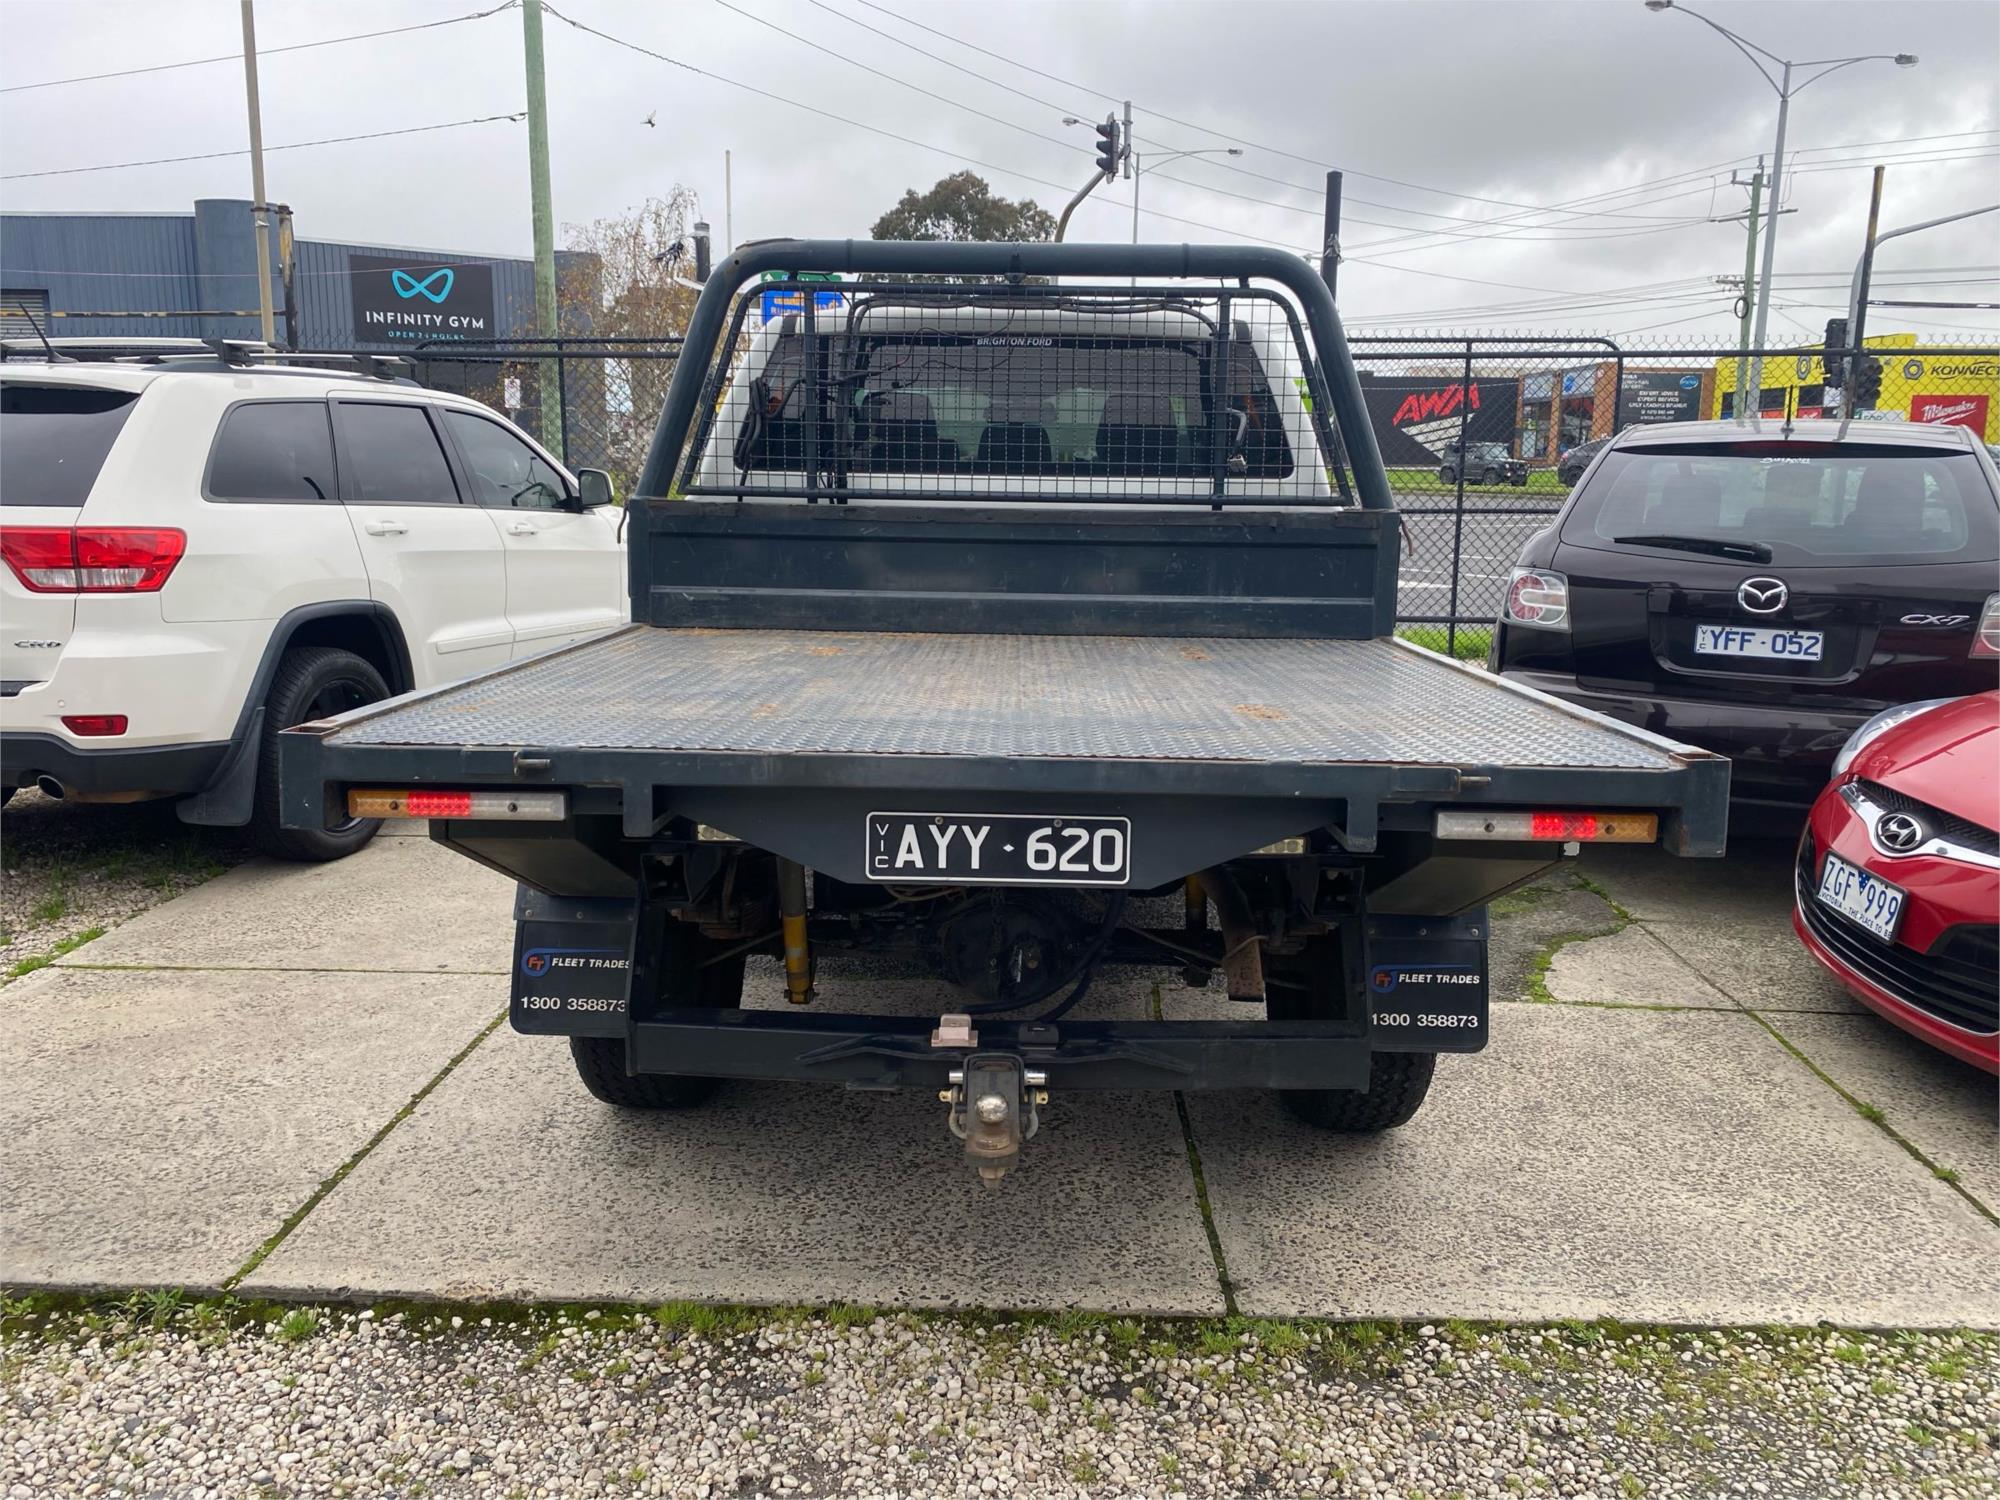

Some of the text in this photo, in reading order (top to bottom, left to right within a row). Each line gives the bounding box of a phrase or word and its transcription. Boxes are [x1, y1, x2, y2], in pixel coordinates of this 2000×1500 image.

[365, 311, 484, 329] INFINITY GYM
[388, 330, 415, 339] OPEN
[1026, 338, 1053, 346] FORD
[1900, 613, 1970, 626] CX-7
[14, 640, 62, 649] CRD
[1699, 629, 1708, 650] VIC
[1710, 629, 1820, 656] YFF 052
[874, 823, 889, 868] VIC
[894, 823, 1124, 873] AYY 620
[1823, 860, 1899, 926] ZGF 999
[1848, 906, 1859, 918] THE
[1859, 911, 1874, 928] PLACE
[1875, 922, 1883, 933] TO
[551, 957, 630, 969] FLEET TRADES
[1398, 973, 1480, 985] FLEET TRADES
[520, 996, 626, 1012] 1300 358873
[1371, 1013, 1478, 1028] 1300 358873
